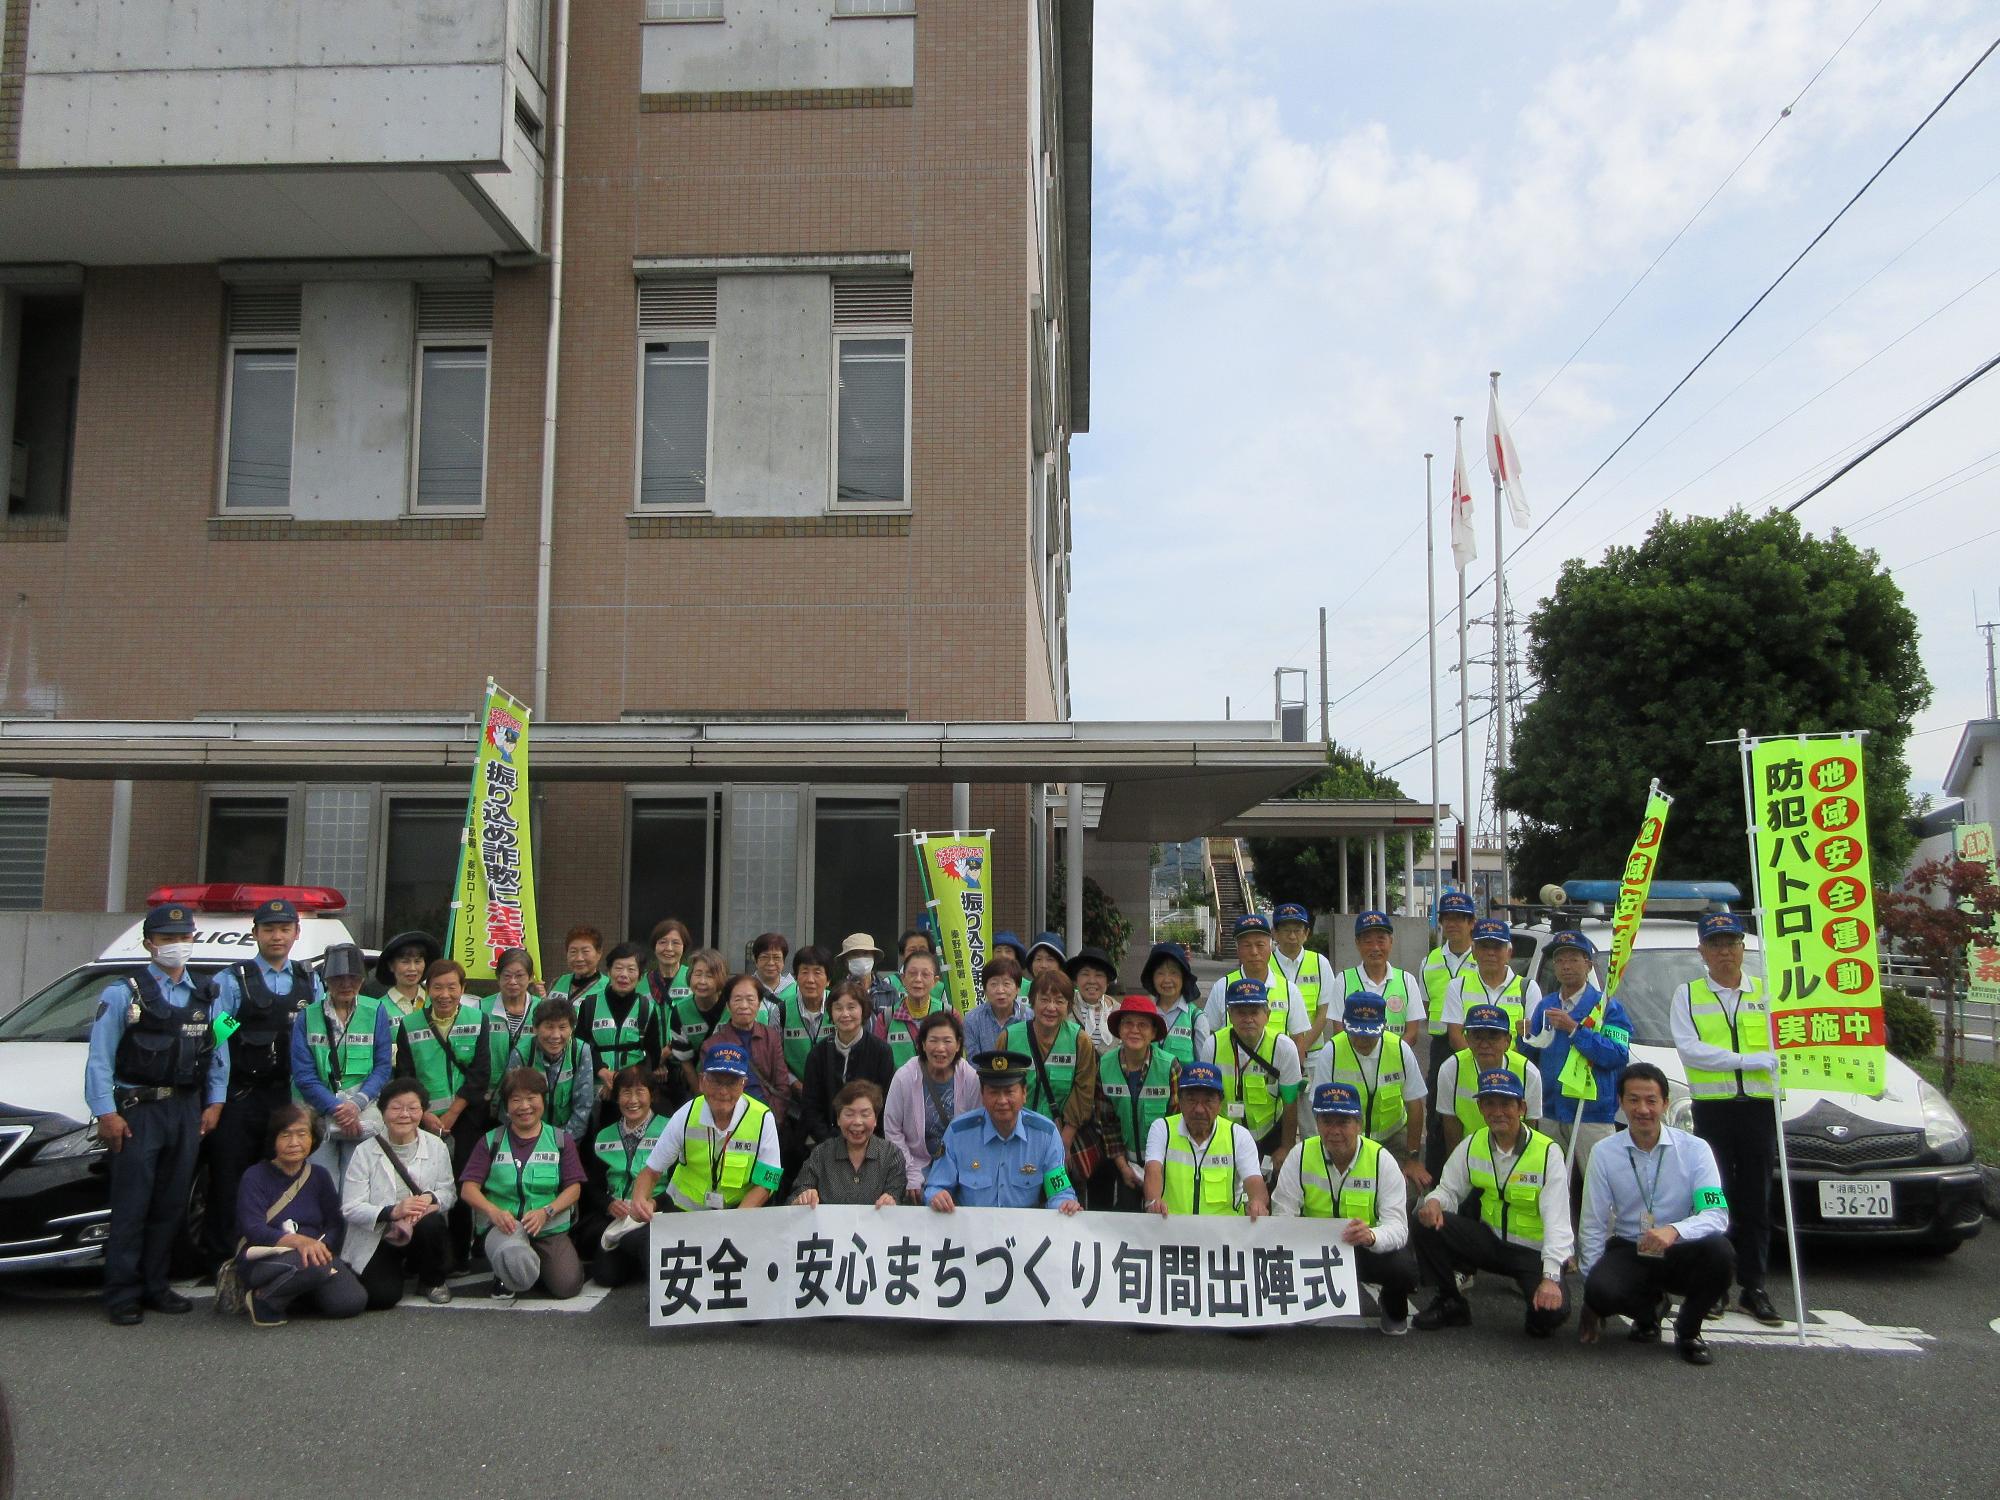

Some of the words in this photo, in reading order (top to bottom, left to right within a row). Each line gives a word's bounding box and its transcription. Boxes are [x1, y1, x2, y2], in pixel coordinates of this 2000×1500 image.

[1765, 758, 1821, 1001] 防犯パトロール
[1814, 759, 1866, 993] 地域安全運動
[194, 931, 257, 947] LICE
[1777, 1012, 1871, 1045] 実施中
[734, 1141, 752, 1150] 防犯
[1212, 1156, 1229, 1165] 防犯
[1353, 1179, 1371, 1189] 防犯
[1519, 1174, 1537, 1184] 防犯
[1836, 1196, 1889, 1215] 36-20
[660, 1232, 1346, 1318] 安全・安心まちづくり旬間出陣式
